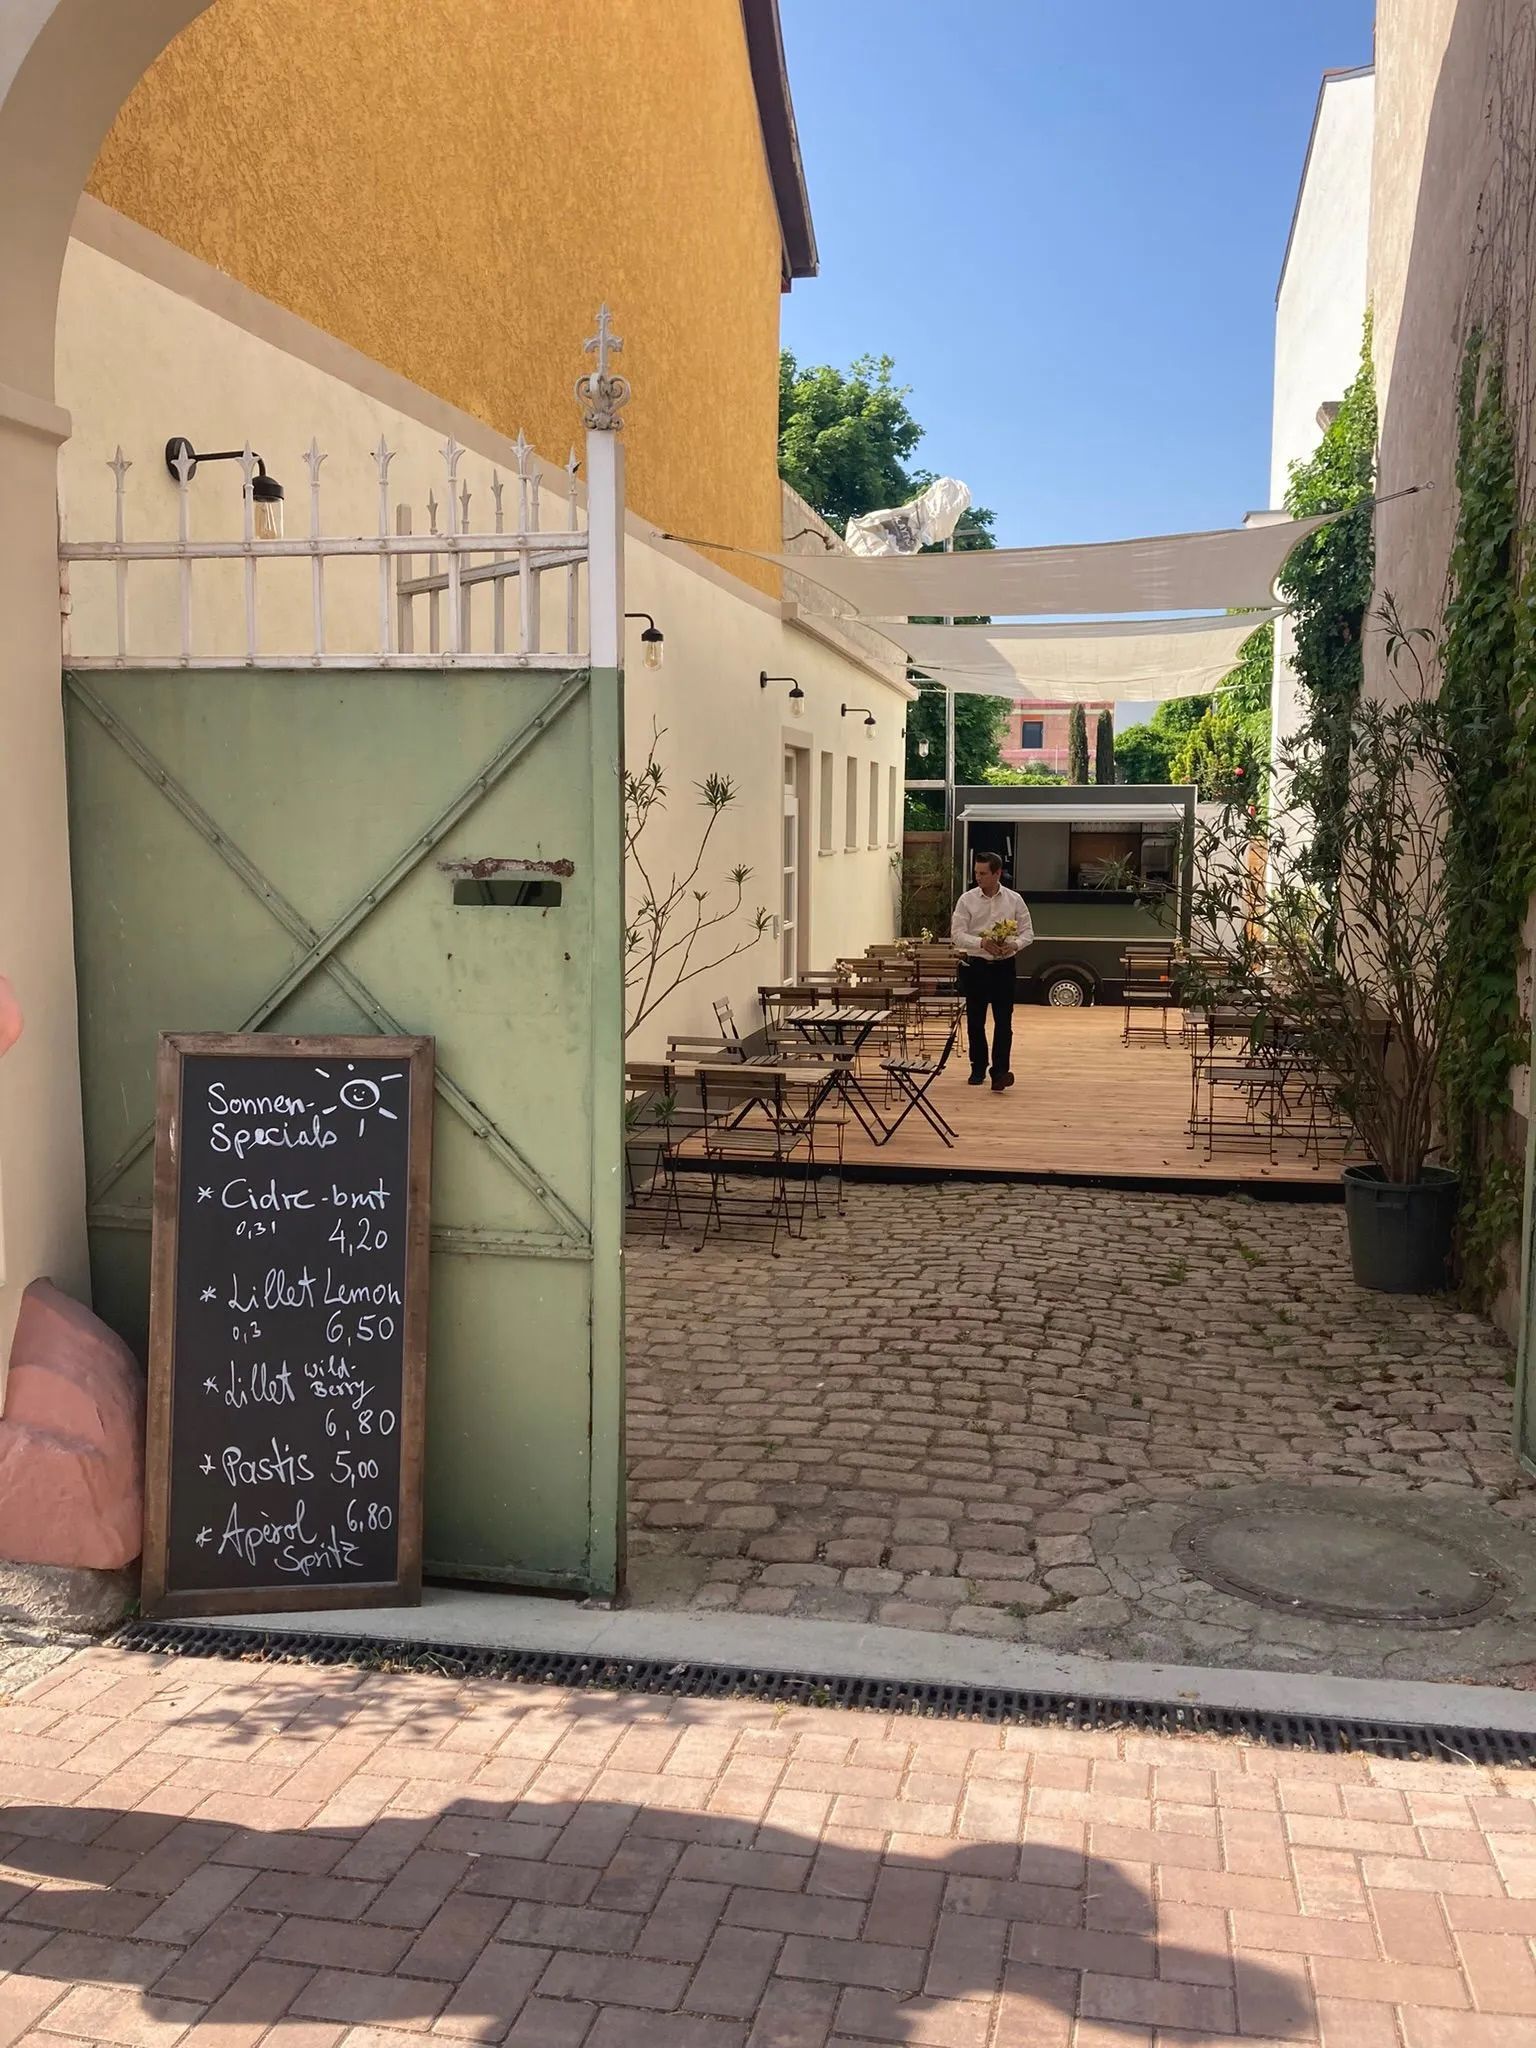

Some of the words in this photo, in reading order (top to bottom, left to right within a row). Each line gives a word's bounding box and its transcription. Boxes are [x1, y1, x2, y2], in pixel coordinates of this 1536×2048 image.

[207, 1082, 316, 1116] Sonnen-
[210, 1114, 338, 1160] Specials
[328, 1217, 389, 1257] 4,20
[227, 1265, 317, 1313] Lillet
[323, 1267, 402, 1305] Lemon
[326, 1309, 395, 1347] 6,50
[224, 1359, 296, 1409] Lillet
[309, 1380, 376, 1410] Berry
[324, 1408, 396, 1441] 6,80
[221, 1436, 316, 1487] Pastis
[330, 1450, 380, 1489] 5,00
[346, 1498, 393, 1533] 6,80
[273, 1524, 364, 1577] Spritz
